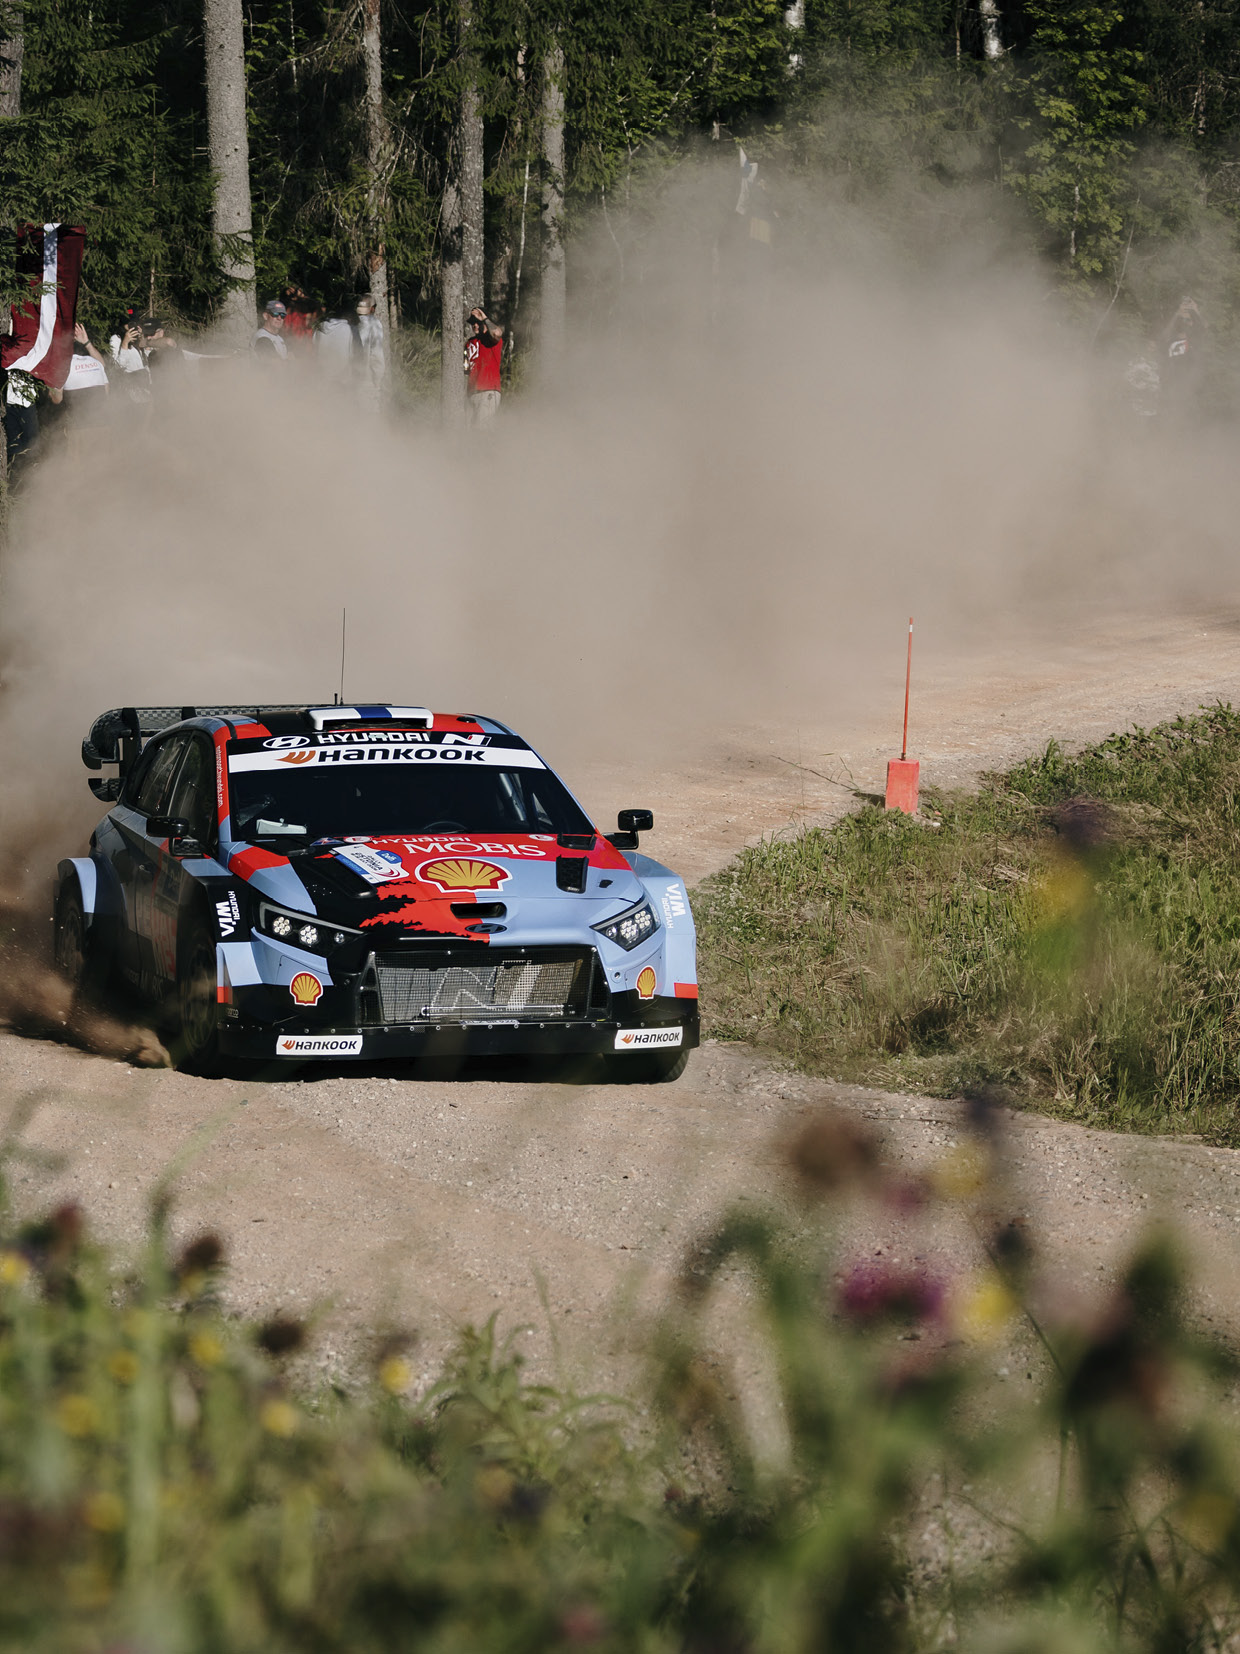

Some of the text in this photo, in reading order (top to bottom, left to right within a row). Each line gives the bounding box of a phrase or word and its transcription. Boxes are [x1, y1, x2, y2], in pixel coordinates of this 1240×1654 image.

[317, 731, 431, 744] HYUNDAI
[371, 836, 472, 845] HYUNDAI
[403, 841, 547, 857] MOBIS
[227, 890, 241, 920] HYUNDAI
[661, 897, 674, 929] HYUNDAI
